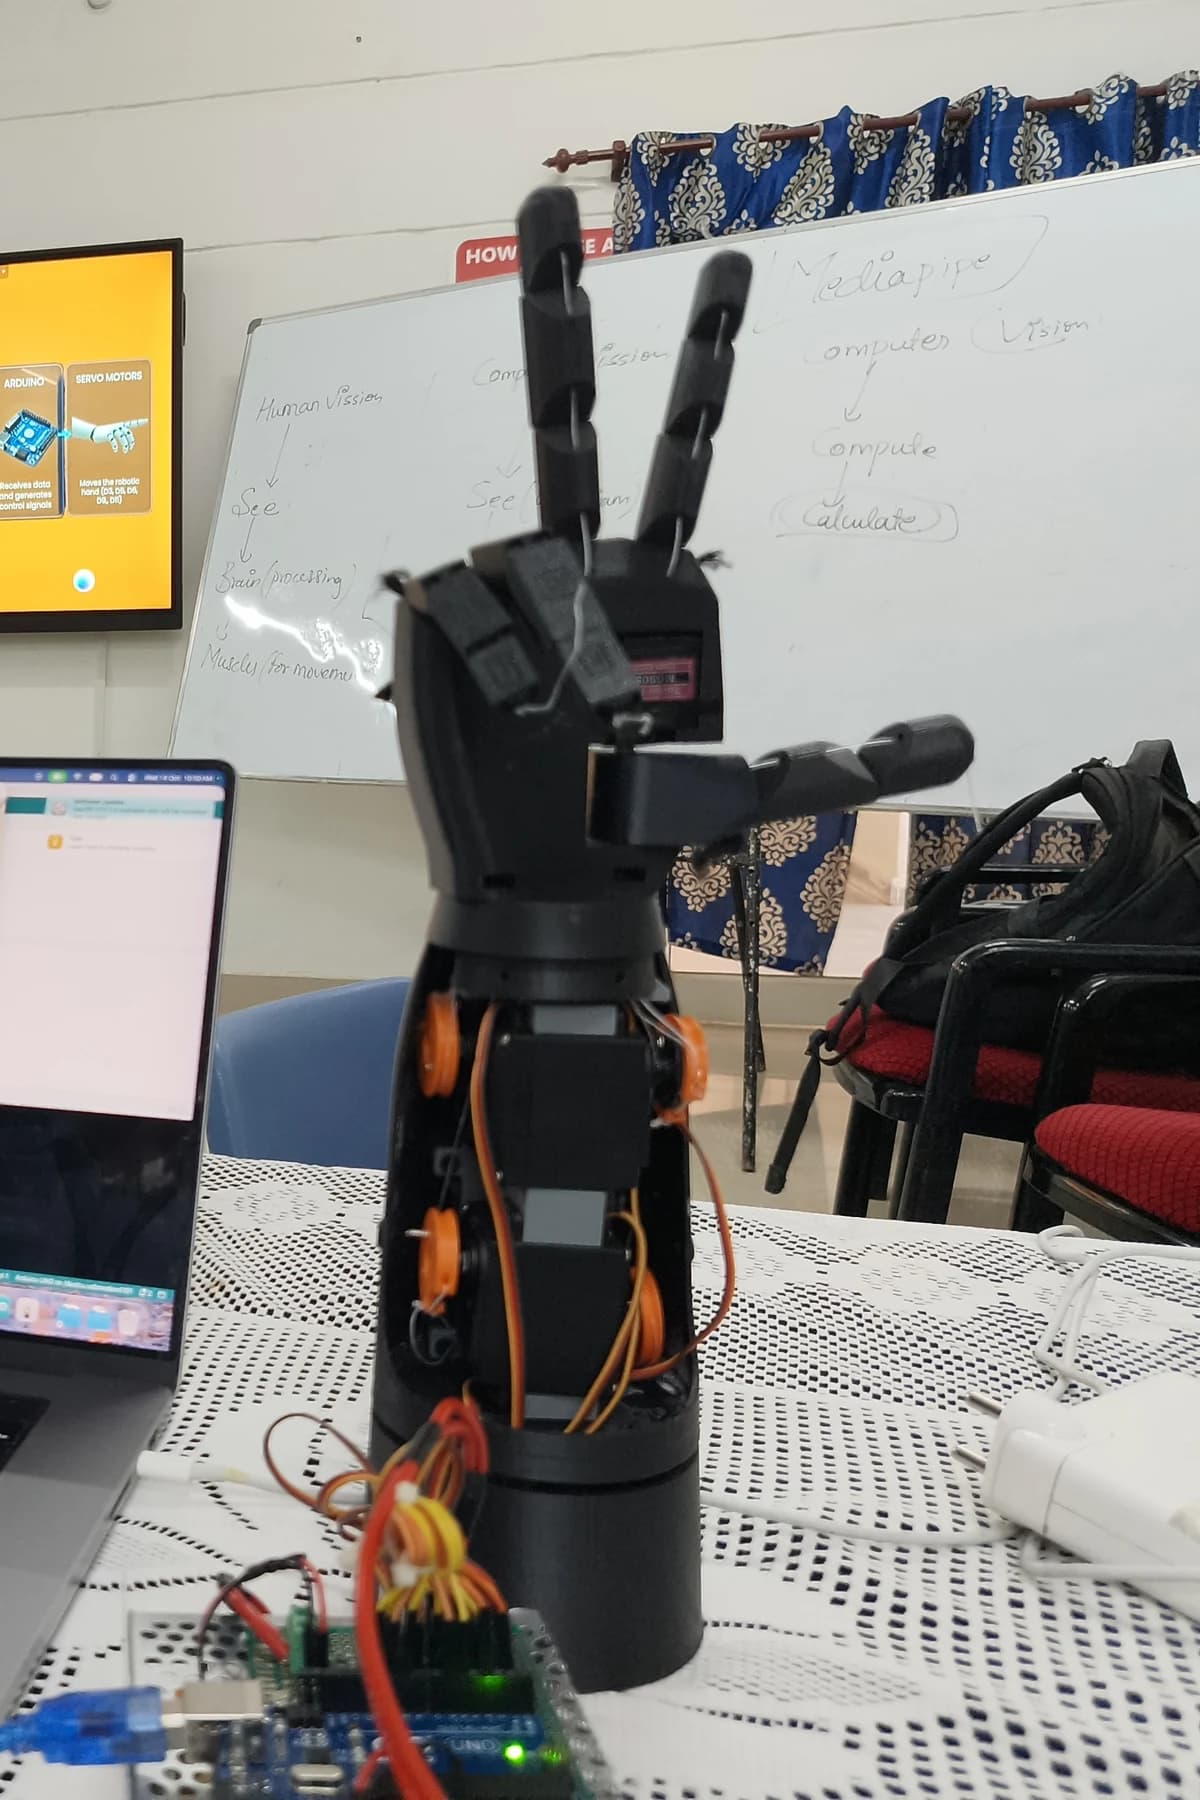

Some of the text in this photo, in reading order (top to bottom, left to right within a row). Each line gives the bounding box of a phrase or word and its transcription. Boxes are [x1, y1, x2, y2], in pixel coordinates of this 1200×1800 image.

[793, 249, 991, 304] Mediapipe
[4, 376, 45, 389] ARDUINO
[76, 371, 143, 384] SERVO MOTORS
[472, 358, 528, 392] Comp
[255, 397, 320, 423] Human
[812, 426, 938, 478] Compute
[0, 480, 51, 490] Receives data
[80, 477, 140, 487] Moves the robotic
[81, 487, 100, 496] hand
[0, 491, 52, 502] and generates
[0, 501, 52, 511] control signals
[231, 487, 279, 517] See
[466, 480, 515, 511] See
[802, 502, 921, 534] Calculate
[215, 561, 261, 594] Brain
